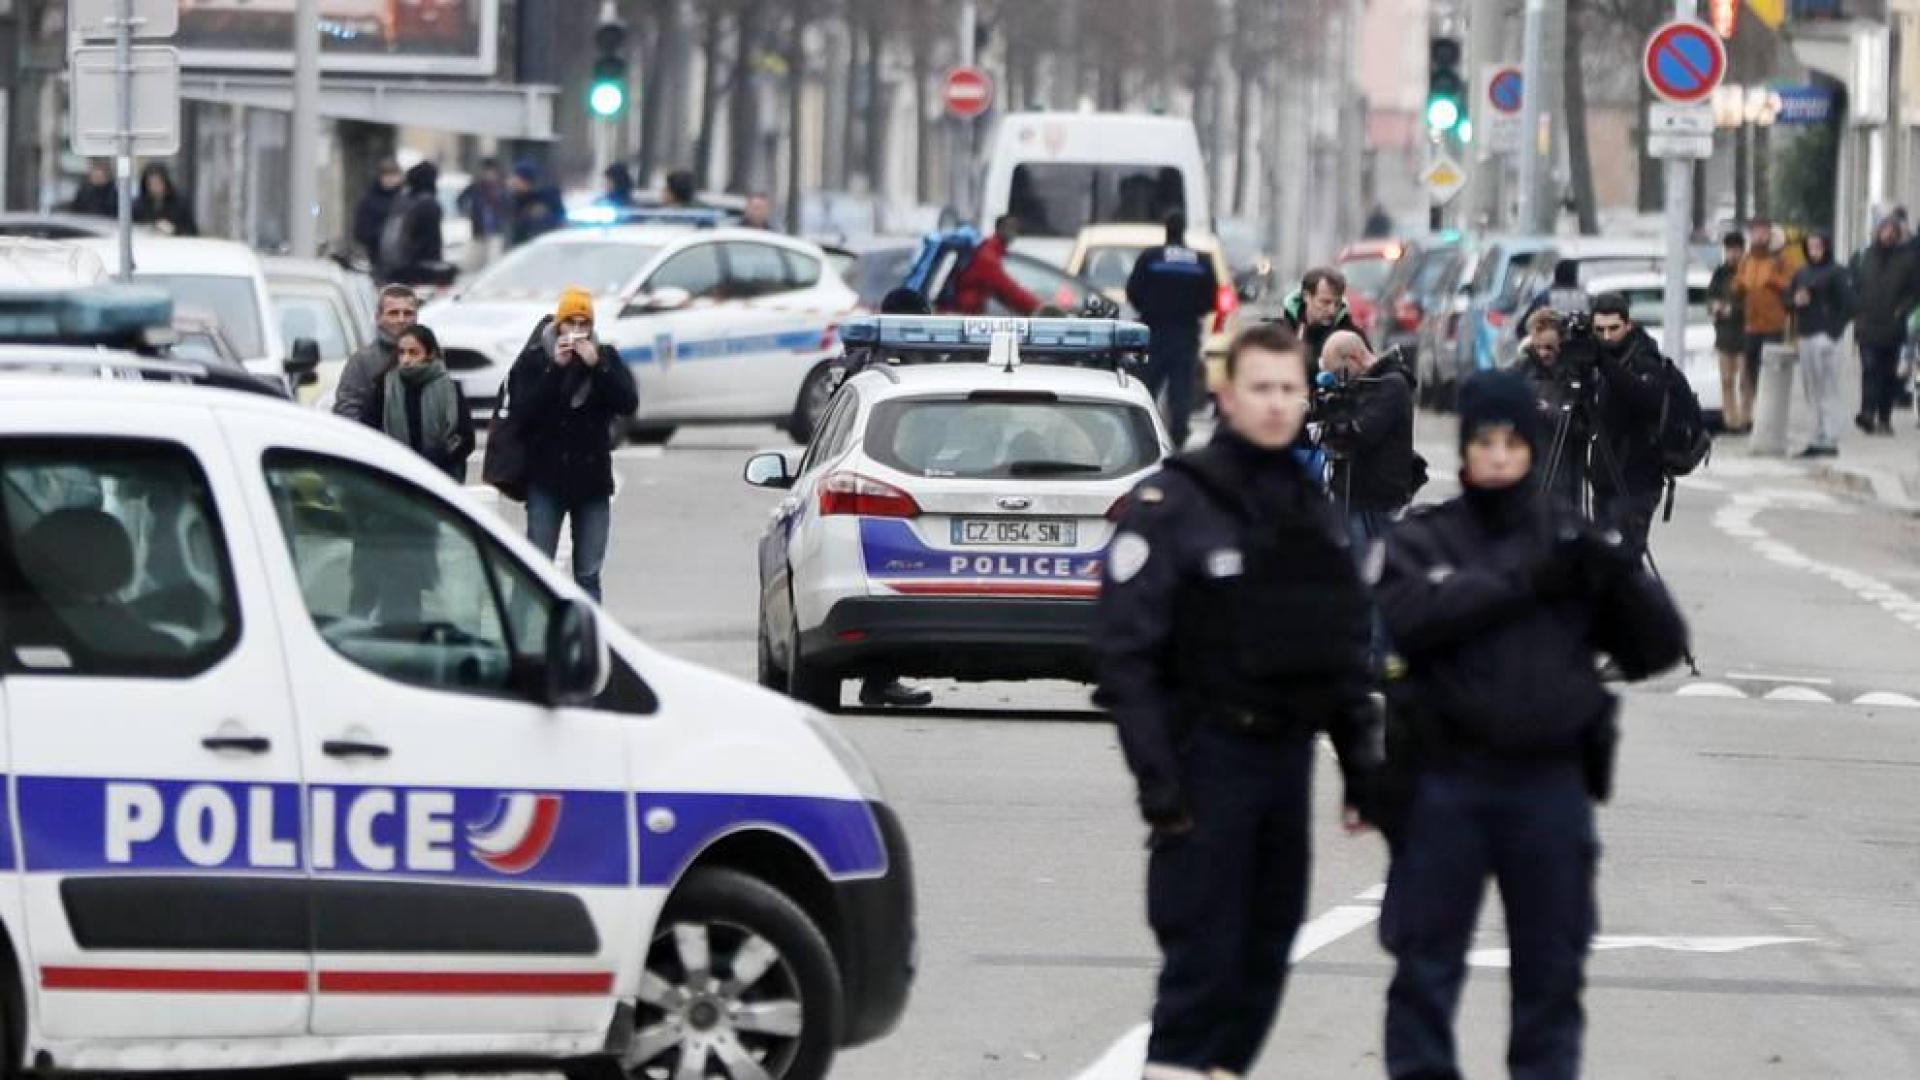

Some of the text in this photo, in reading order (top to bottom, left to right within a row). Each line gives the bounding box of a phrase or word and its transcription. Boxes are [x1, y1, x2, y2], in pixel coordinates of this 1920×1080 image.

[966, 318, 1027, 334] POLICE
[966, 522, 1060, 541] CZ 054 SN
[951, 556, 1071, 576] POLICE
[105, 783, 455, 871] POLICE
